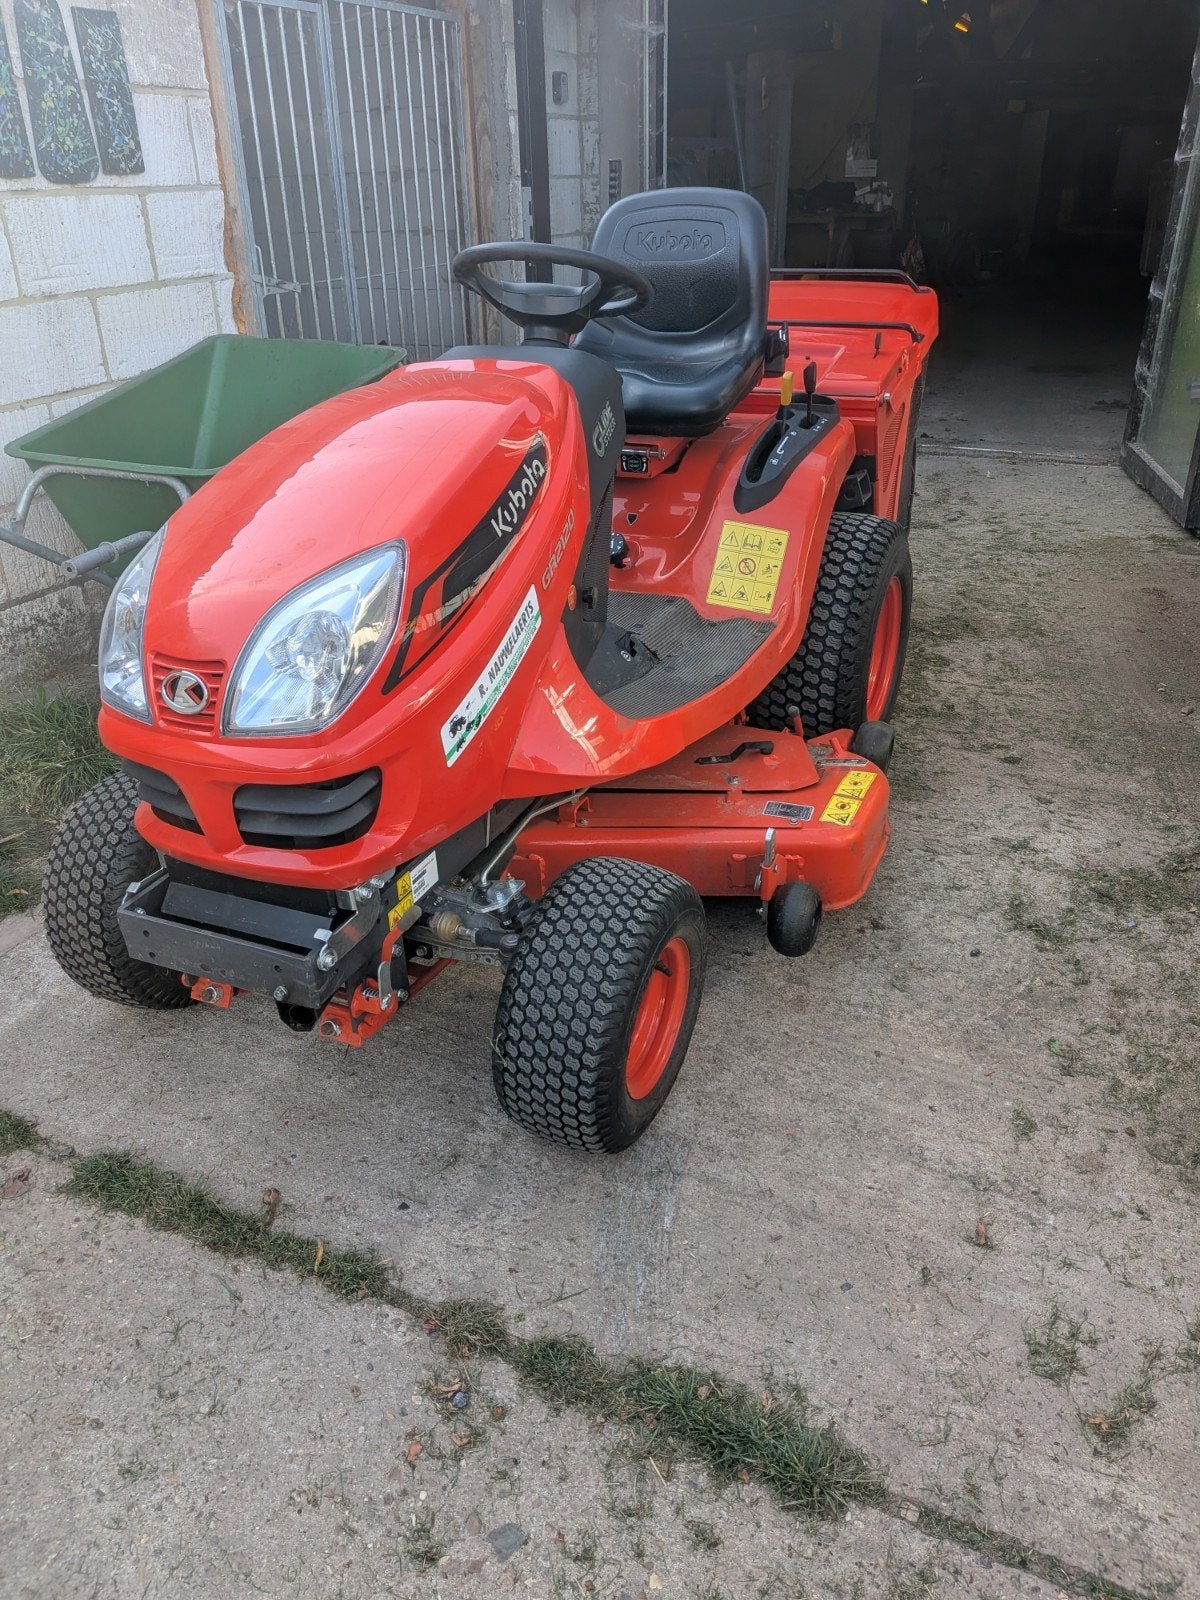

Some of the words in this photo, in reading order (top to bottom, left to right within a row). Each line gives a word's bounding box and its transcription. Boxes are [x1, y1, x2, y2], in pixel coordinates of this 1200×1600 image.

[636, 229, 713, 252] Kubota
[490, 459, 545, 537] Kubota
[541, 508, 575, 590] GR2120
[478, 683, 489, 699] R.
[487, 600, 534, 684] NAUWELAERTS
